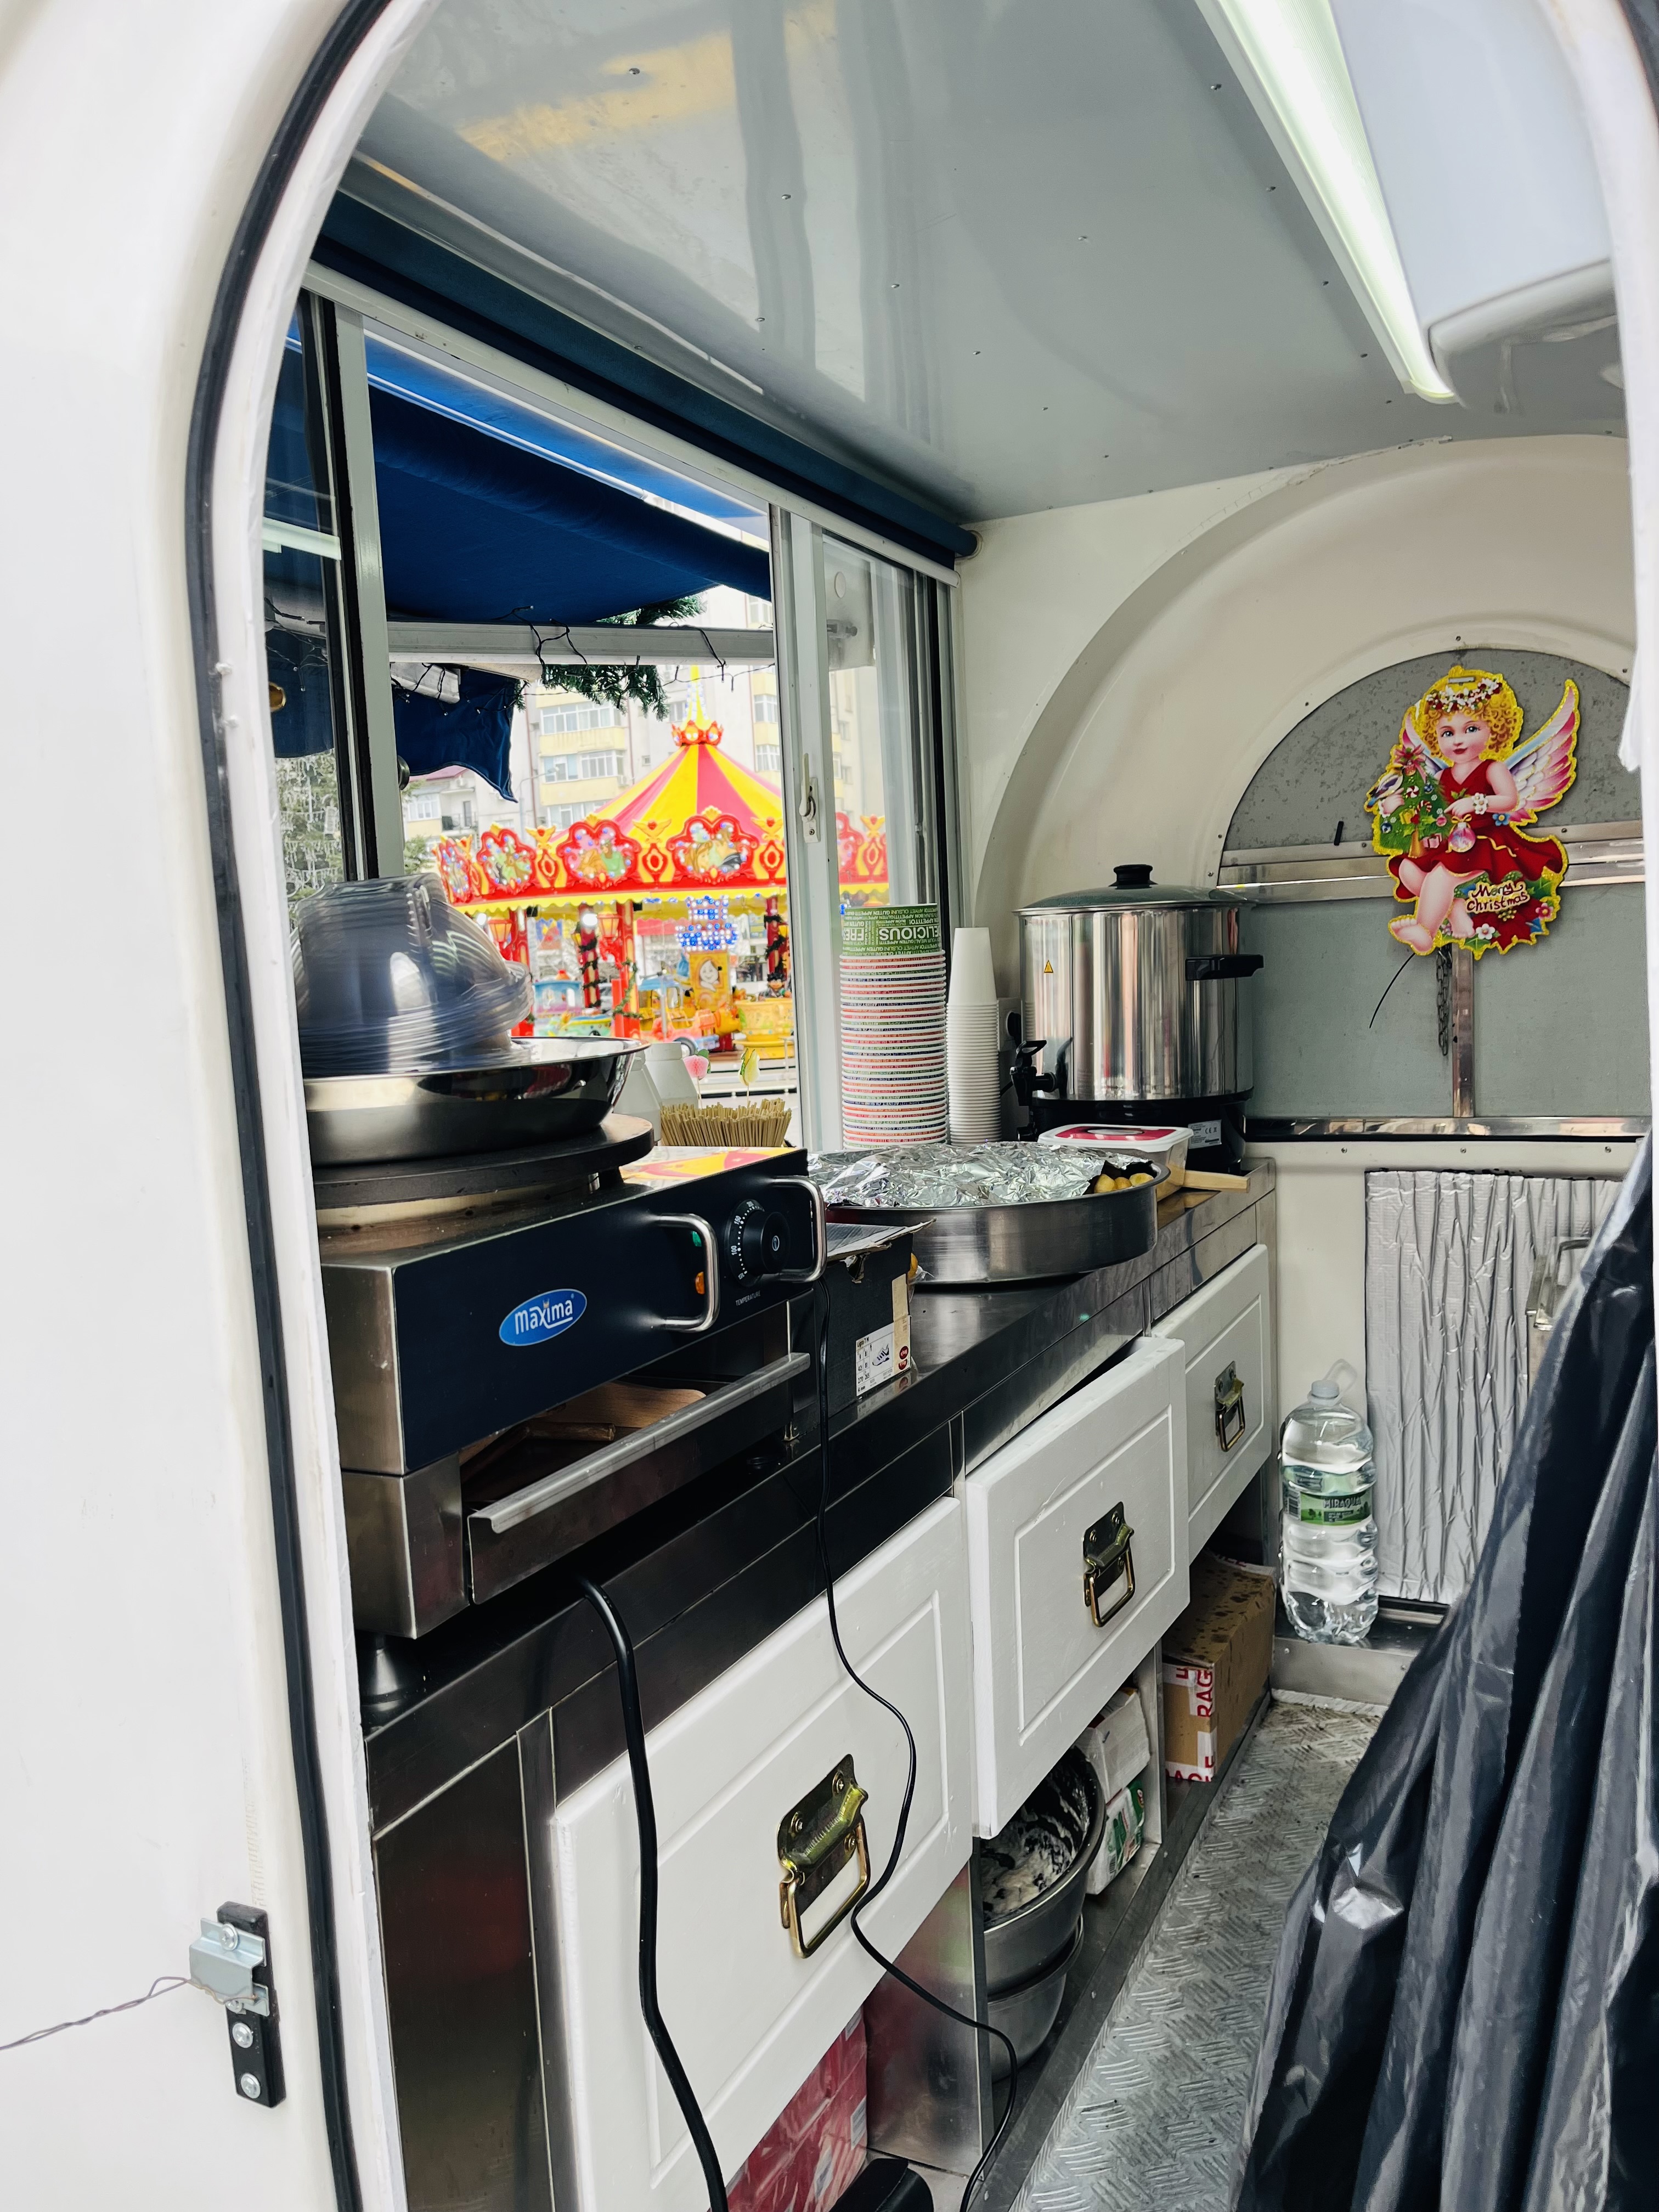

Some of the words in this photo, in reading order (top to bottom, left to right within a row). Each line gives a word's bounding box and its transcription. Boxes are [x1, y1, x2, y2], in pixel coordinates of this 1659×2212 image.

[1471, 883, 1523, 898] Merry
[733, 1215, 742, 1225] 150
[735, 1290, 761, 1307] TEMPERATURE
[1322, 1497, 1362, 1508] MIRAQUA
